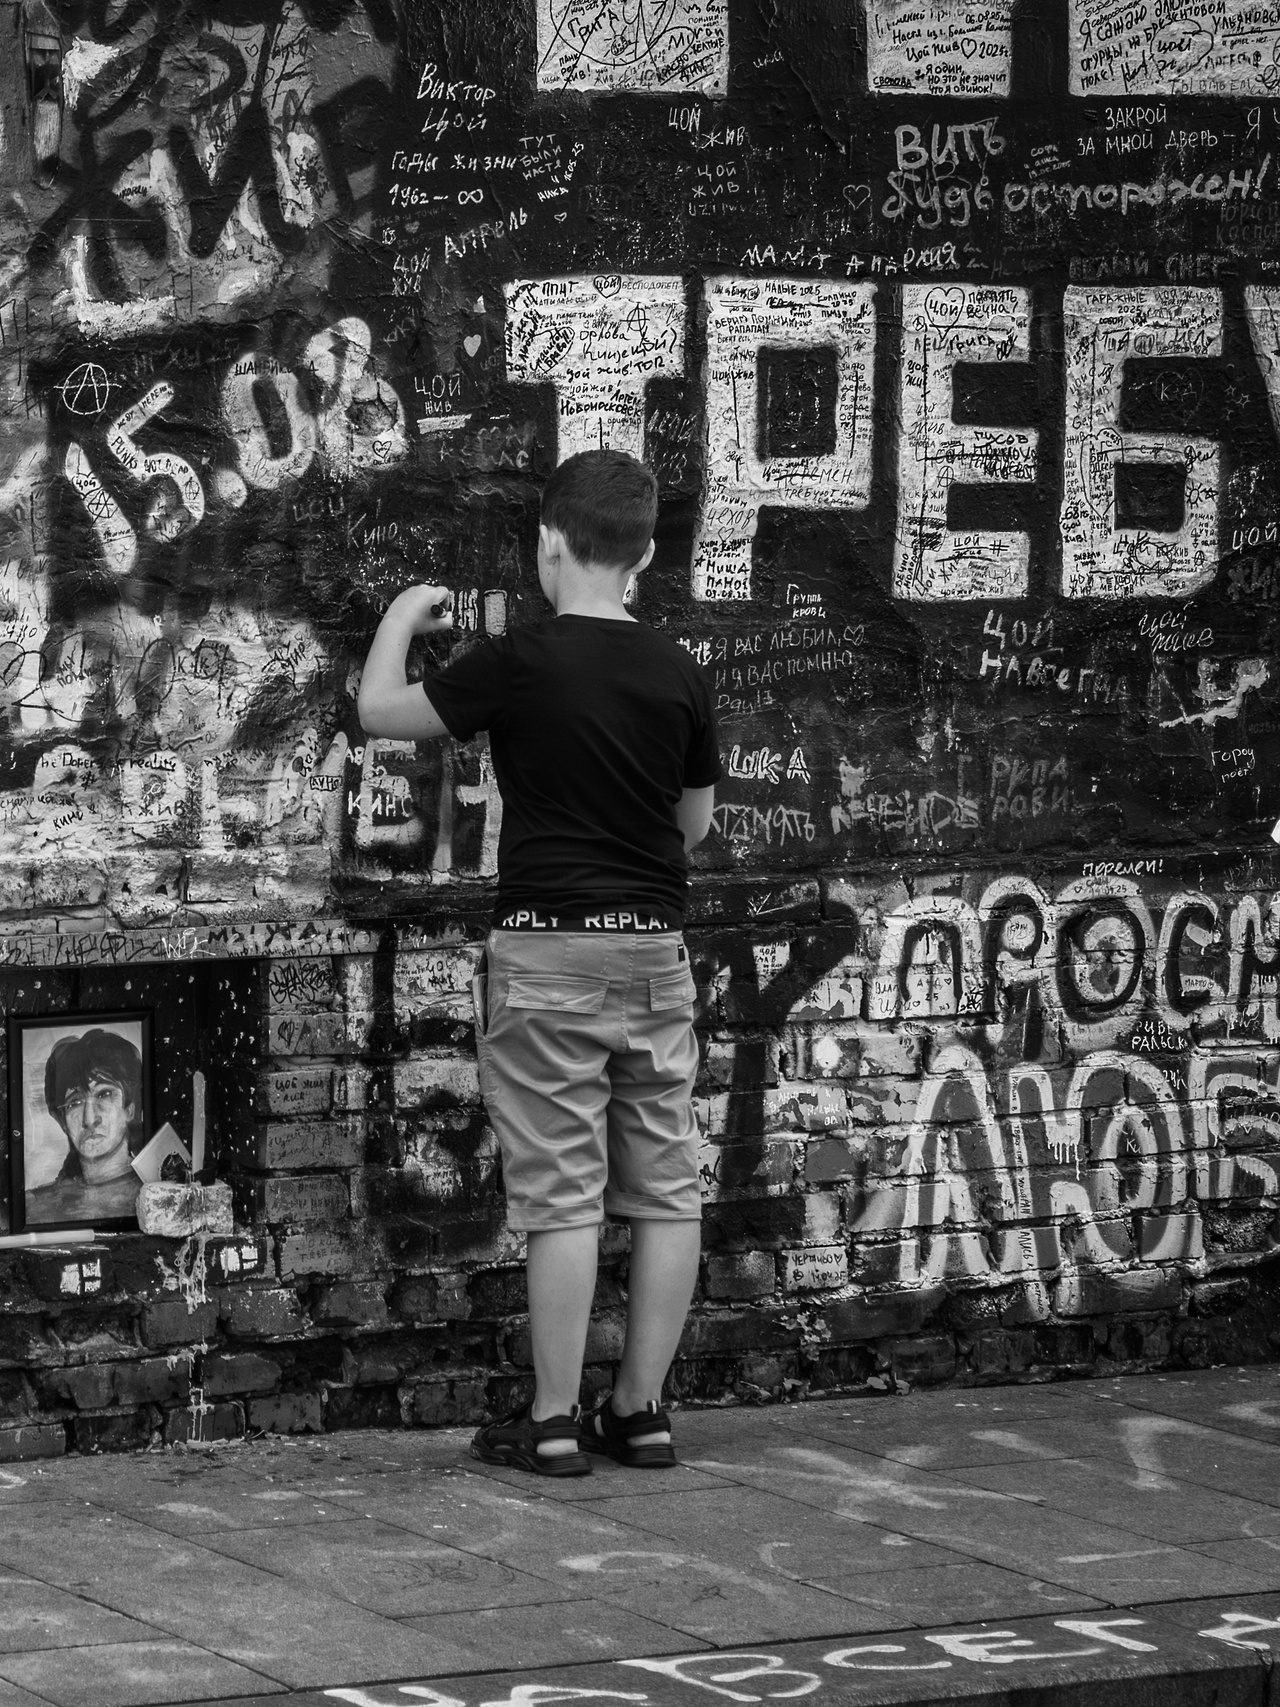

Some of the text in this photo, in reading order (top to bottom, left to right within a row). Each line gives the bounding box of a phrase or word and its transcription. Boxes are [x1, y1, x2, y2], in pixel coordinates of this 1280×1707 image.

[906, 44, 930, 63] Цой
[942, 74, 958, 84] это
[972, 73, 1007, 84] значит
[421, 107, 487, 142] Цой
[670, 103, 701, 132] ЦОЙ
[1105, 103, 1167, 131] ЗАКРОЙ
[519, 133, 557, 150] ТУТ
[701, 125, 746, 149] ЖИВ
[1077, 106, 1261, 156] ЗА МНОЙ ДВЕРЬ Я
[520, 144, 562, 168] БЫЛИ
[522, 158, 562, 181] НАСТЯ
[697, 164, 737, 182] ЦОЙ
[389, 183, 429, 208] 1962
[692, 180, 740, 199] ЖИВ
[1004, 152, 1272, 216] осторожен!
[929, 299, 960, 317] ЦОЙ
[1085, 293, 1148, 306] ГАРАЖНЫЕ
[1117, 305, 1142, 314] 2025
[414, 373, 462, 400] ЦОЙ
[111, 434, 138, 470] PUNKS
[953, 534, 981, 548] ЦОЙ
[1231, 521, 1278, 554] ЦОЙ
[982, 608, 1056, 650] ЦОЙ
[715, 637, 728, 661] Я
[734, 634, 763, 656] ВАС
[715, 669, 726, 690] И
[731, 667, 743, 690] Я
[747, 661, 783, 686] ВАС
[584, 911, 668, 930] REPLA
